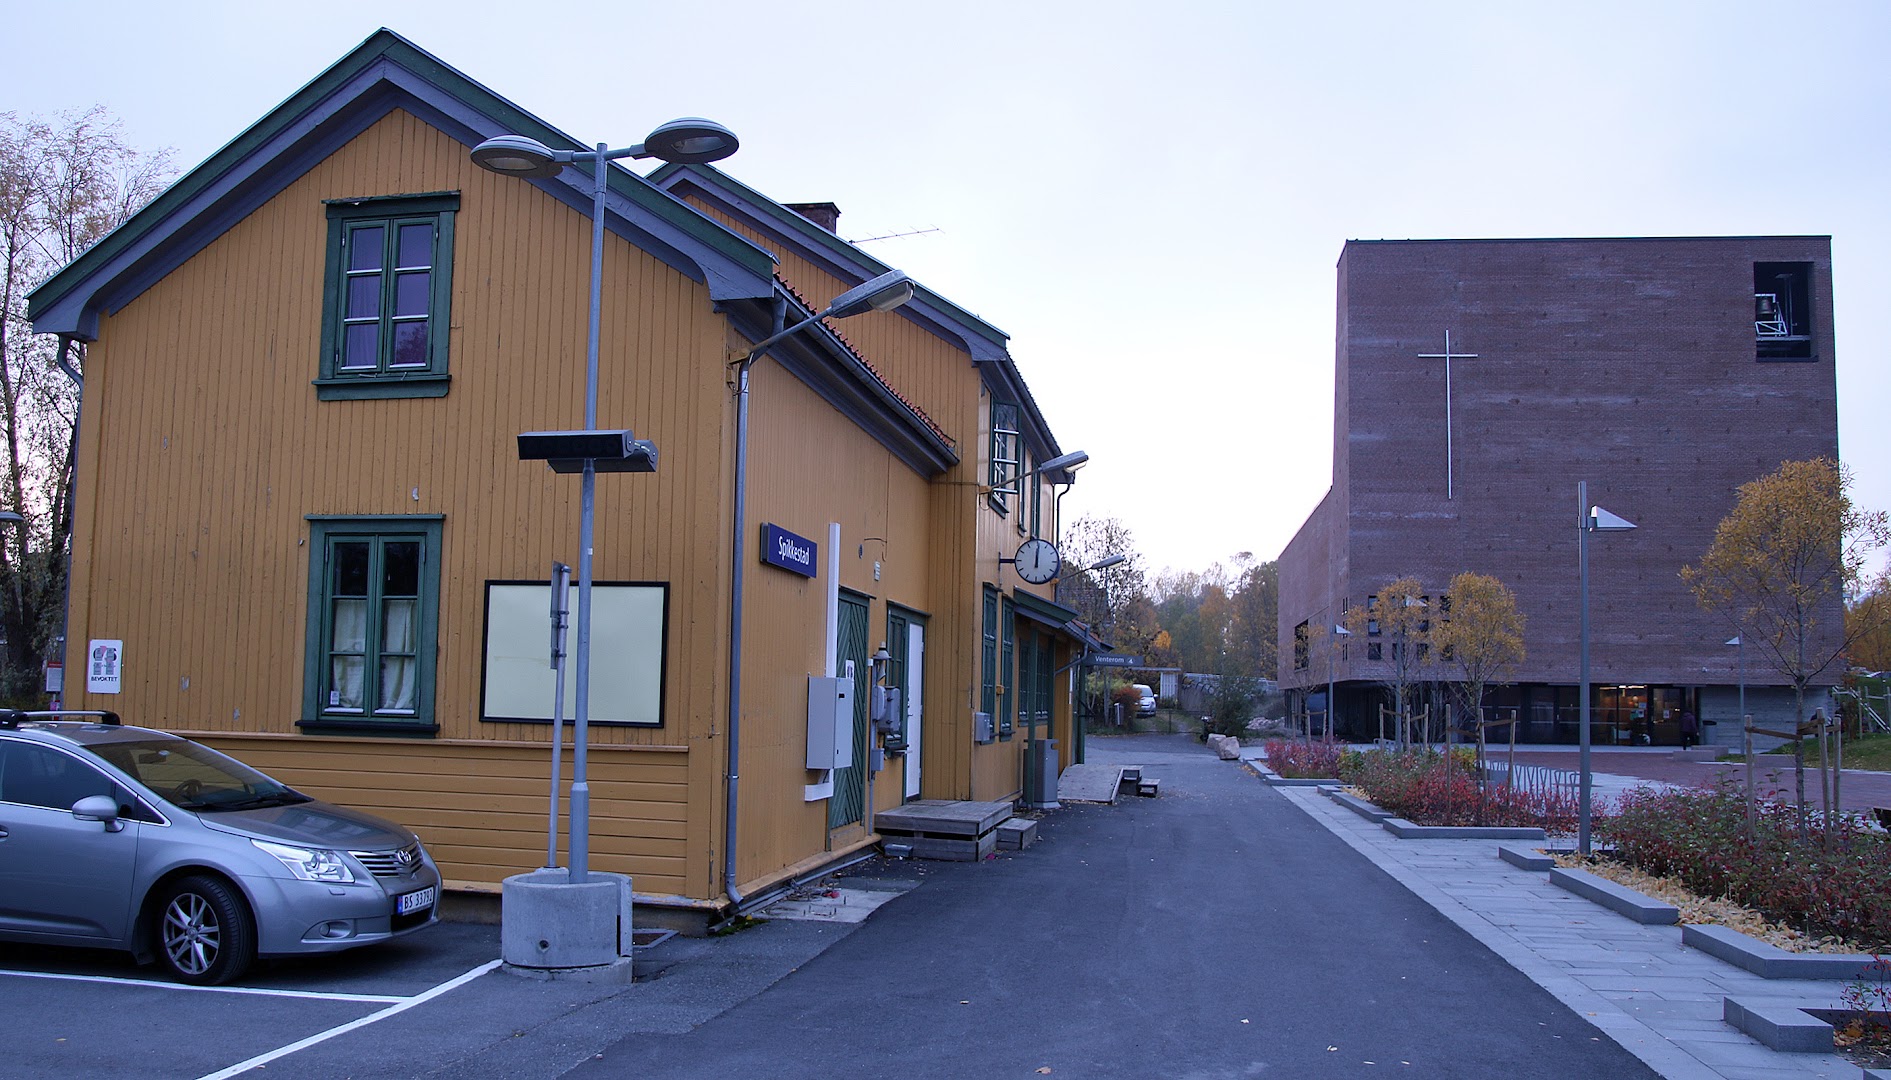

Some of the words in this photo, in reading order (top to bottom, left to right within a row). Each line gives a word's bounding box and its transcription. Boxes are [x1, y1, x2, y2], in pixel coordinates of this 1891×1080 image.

[778, 535, 810, 566] Spikkestad
[1095, 655, 1125, 663] Venterom
[404, 895, 413, 909] BS
